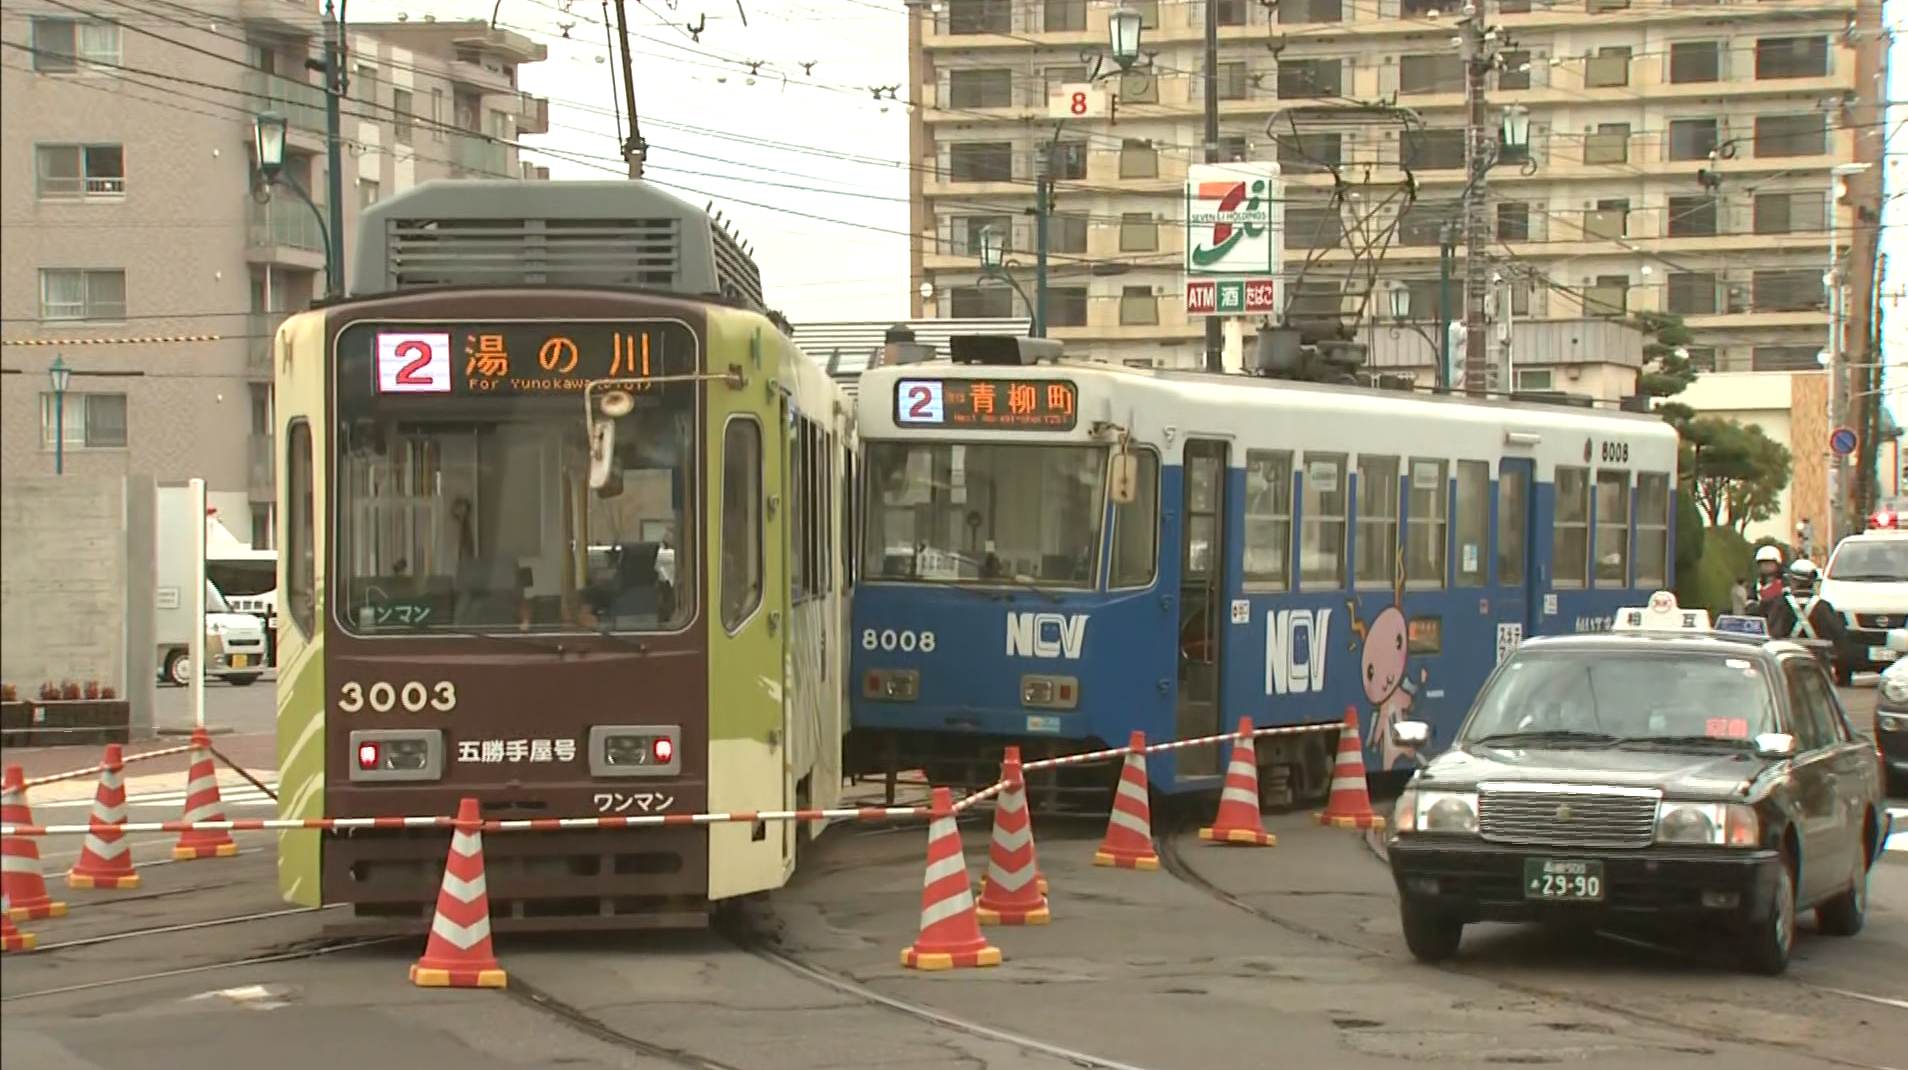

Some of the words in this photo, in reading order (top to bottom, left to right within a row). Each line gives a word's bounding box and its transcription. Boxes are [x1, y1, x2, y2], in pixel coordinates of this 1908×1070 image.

[1070, 91, 1088, 115] 8
[1191, 213, 1215, 222] SEVEN
[1226, 211, 1266, 221] HOLDINGS
[1188, 286, 1214, 308] ATM
[1221, 286, 1239, 307] 酒
[1246, 285, 1273, 306] たばこ
[395, 340, 433, 385] 2
[465, 333, 650, 377] 湯の川
[469, 379, 500, 390] For
[908, 386, 933, 418] 2
[970, 382, 1072, 415] 青柳町
[1602, 441, 1629, 463] 8008
[377, 605, 431, 623] ンマン
[862, 628, 936, 653] 8008
[1006, 611, 1090, 660] NCV
[1265, 607, 1333, 696] NCV
[338, 681, 457, 712] 3003
[457, 739, 577, 763] 五勝手屋号
[594, 793, 674, 812] ワンマン
[1543, 874, 1599, 897] 29-90
